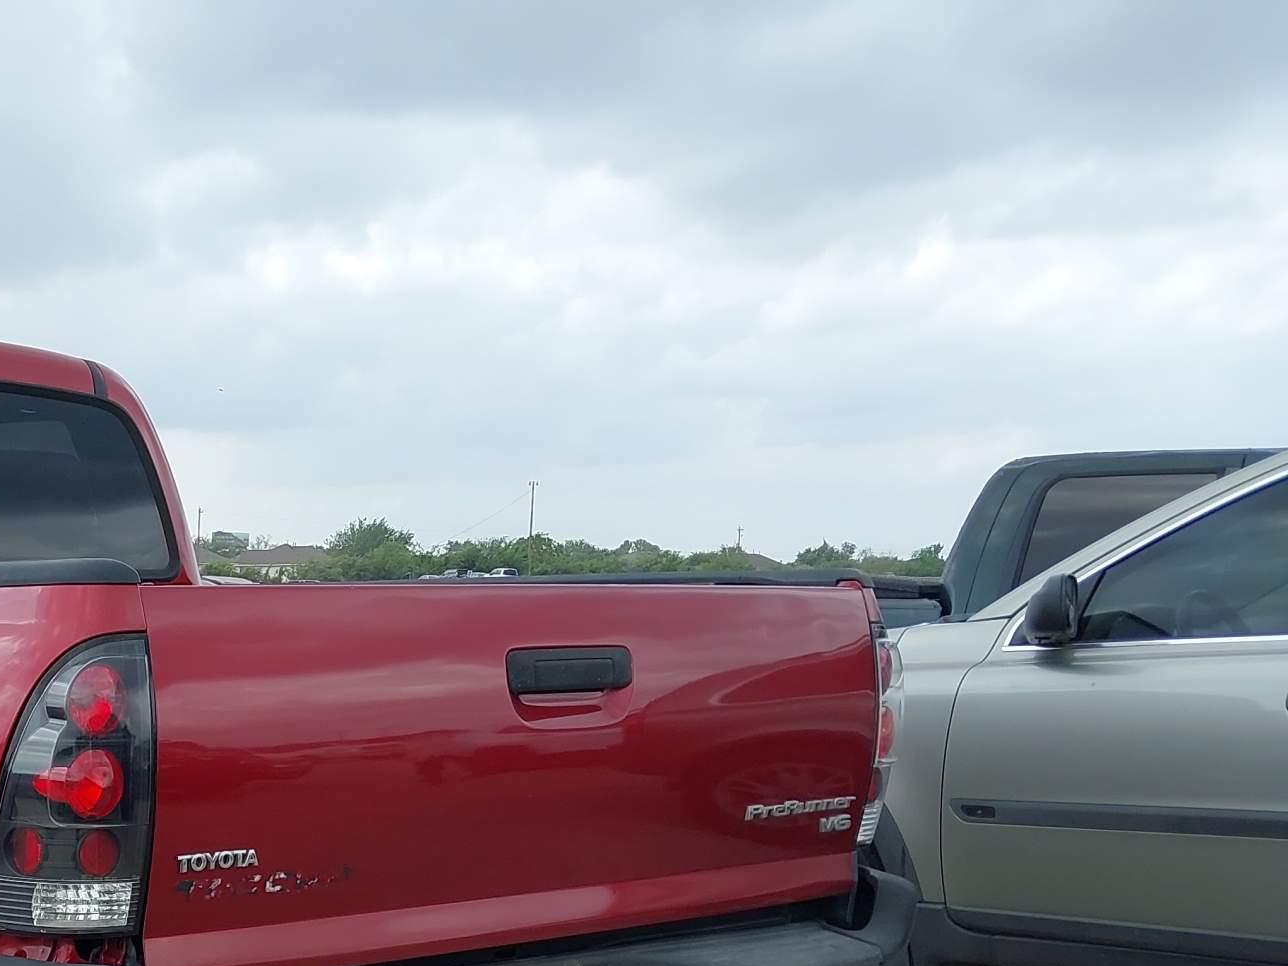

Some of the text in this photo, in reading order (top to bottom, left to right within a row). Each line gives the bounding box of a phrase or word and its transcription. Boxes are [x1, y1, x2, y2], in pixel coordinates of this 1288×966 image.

[744, 796, 856, 821] PreRunner
[819, 814, 852, 832] V6
[177, 849, 260, 874] TOYOTA
